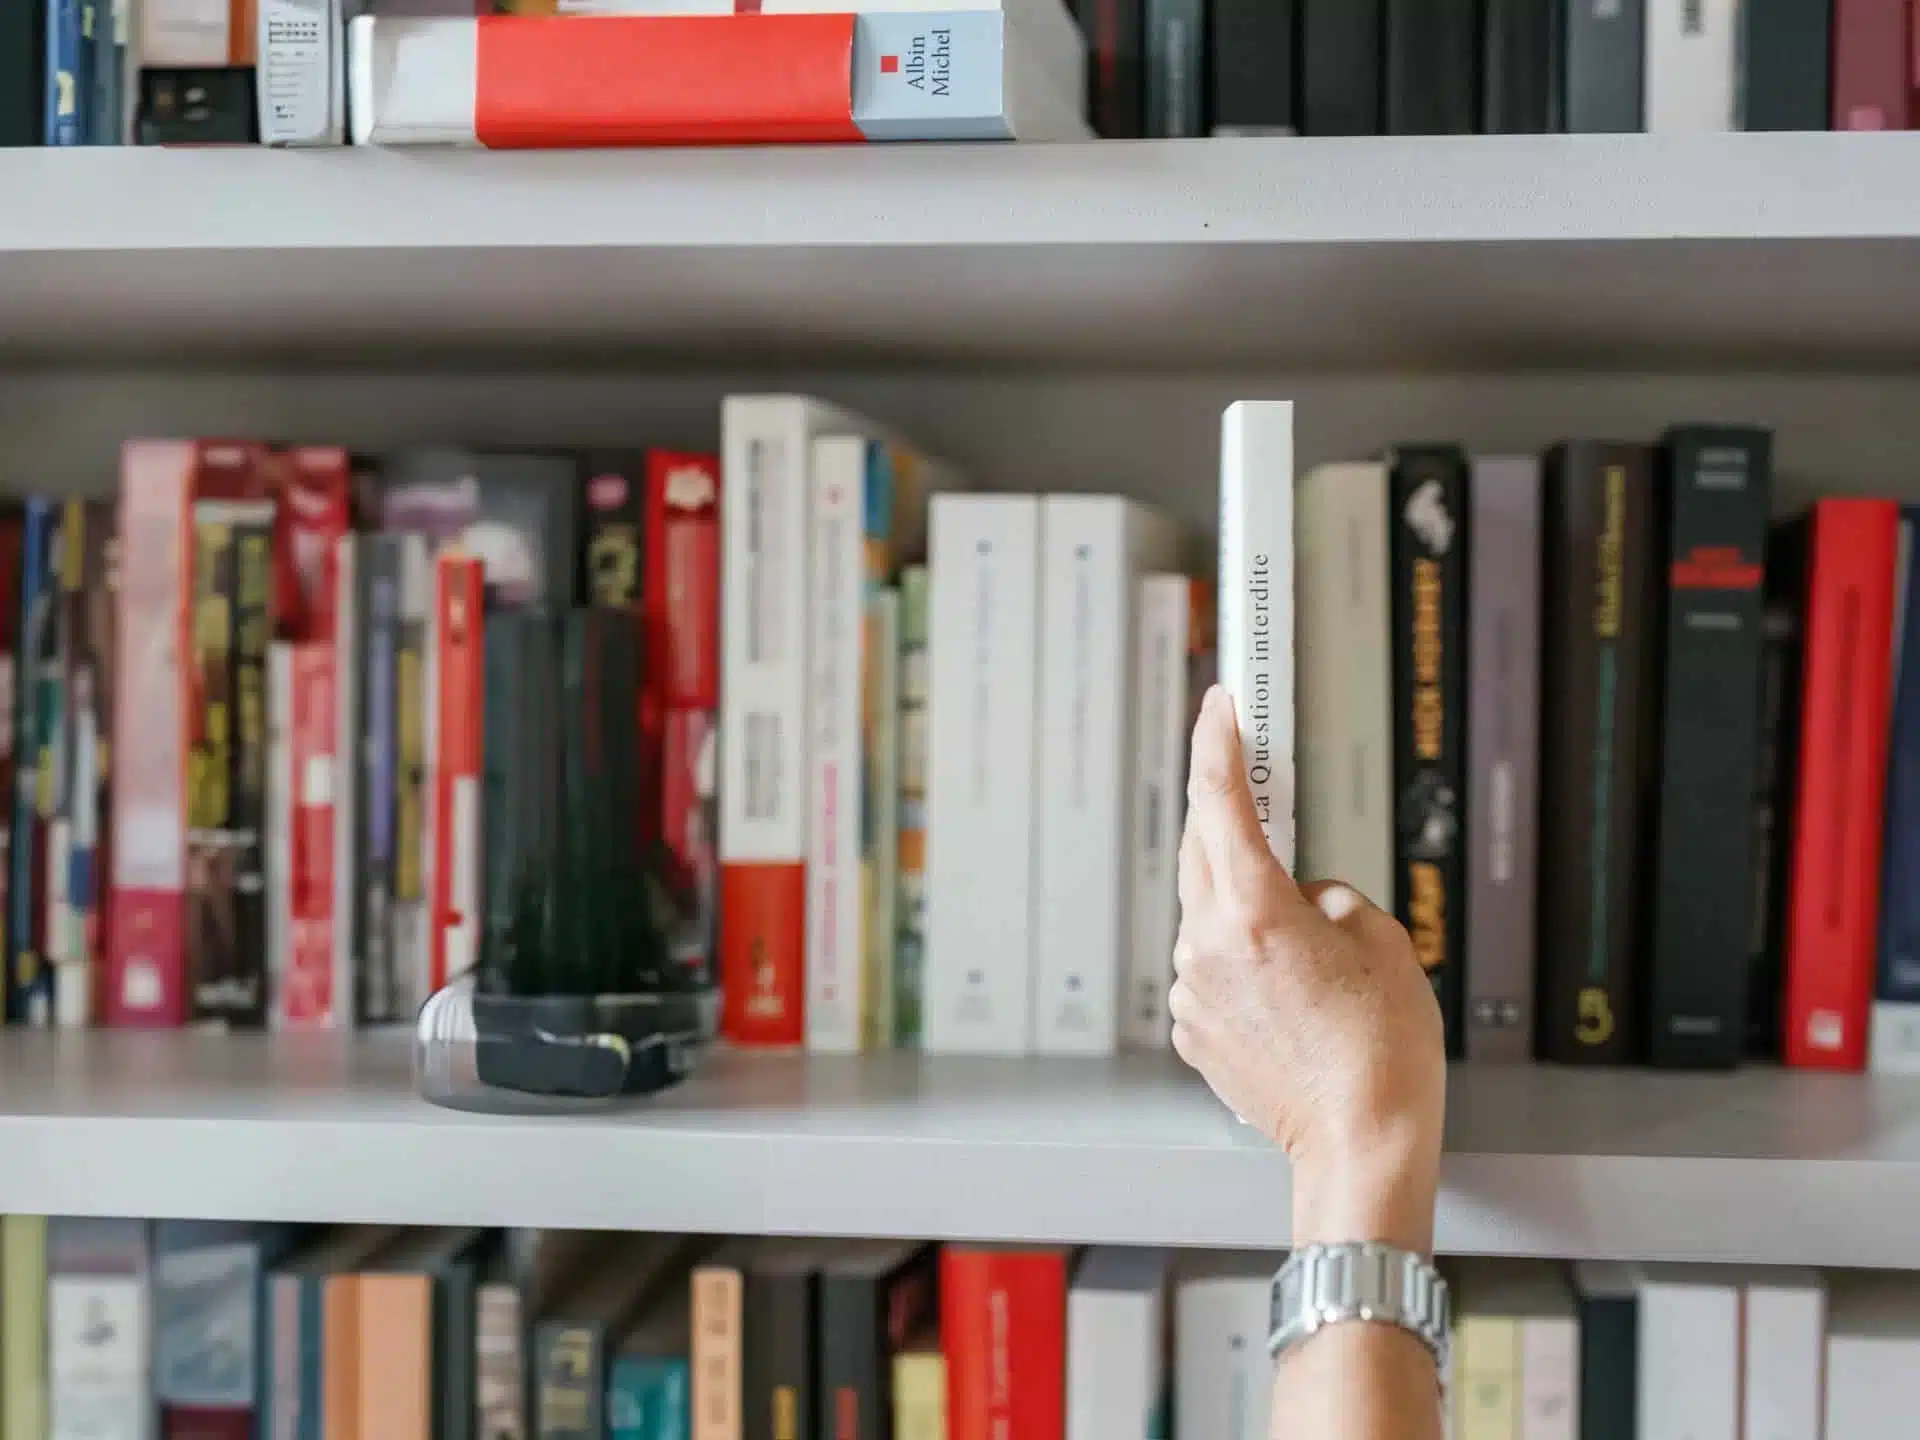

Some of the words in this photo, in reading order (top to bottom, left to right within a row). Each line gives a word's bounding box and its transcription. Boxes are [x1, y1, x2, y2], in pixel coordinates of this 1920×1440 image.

[905, 36, 925, 91] Albin
[931, 28, 951, 97] Michel
[1249, 553, 1270, 662] interdite
[1249, 673, 1271, 785] Question
